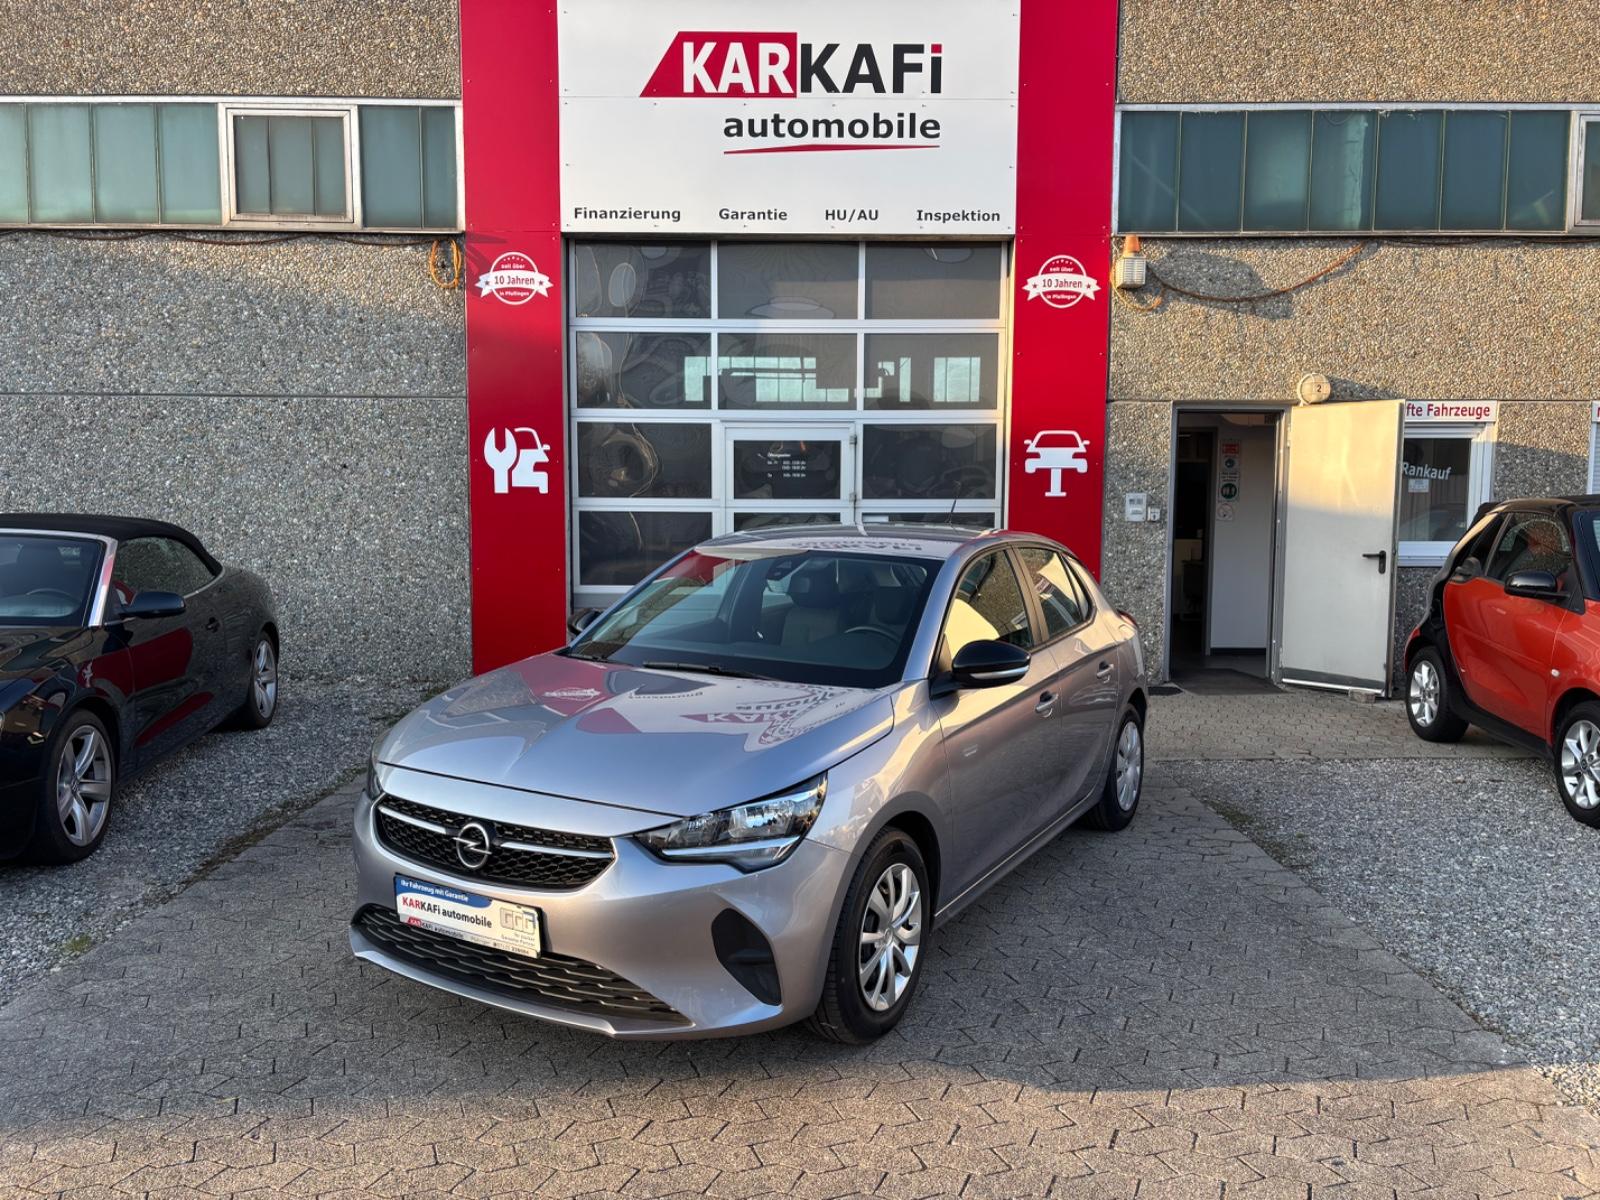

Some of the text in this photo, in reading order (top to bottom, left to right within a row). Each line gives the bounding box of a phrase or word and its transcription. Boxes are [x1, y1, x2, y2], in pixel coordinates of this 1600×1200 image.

[682, 41, 943, 95] KARKAFi
[723, 113, 941, 139] automobile
[574, 207, 681, 223] Finanzierung
[718, 208, 788, 221] Garantie
[825, 208, 879, 222] HU/AU
[916, 209, 1001, 224] Inspektion
[494, 275, 535, 285] 10 Jahren
[1042, 278, 1083, 288] 10 Jahren
[1316, 384, 1322, 393] 2
[1426, 403, 1490, 420] Fahrzeuge
[409, 881, 434, 895] Fahrzeug
[435, 887, 445, 896] mit
[445, 889, 469, 902] Garantie
[402, 895, 492, 928] KARKAFi automobile
